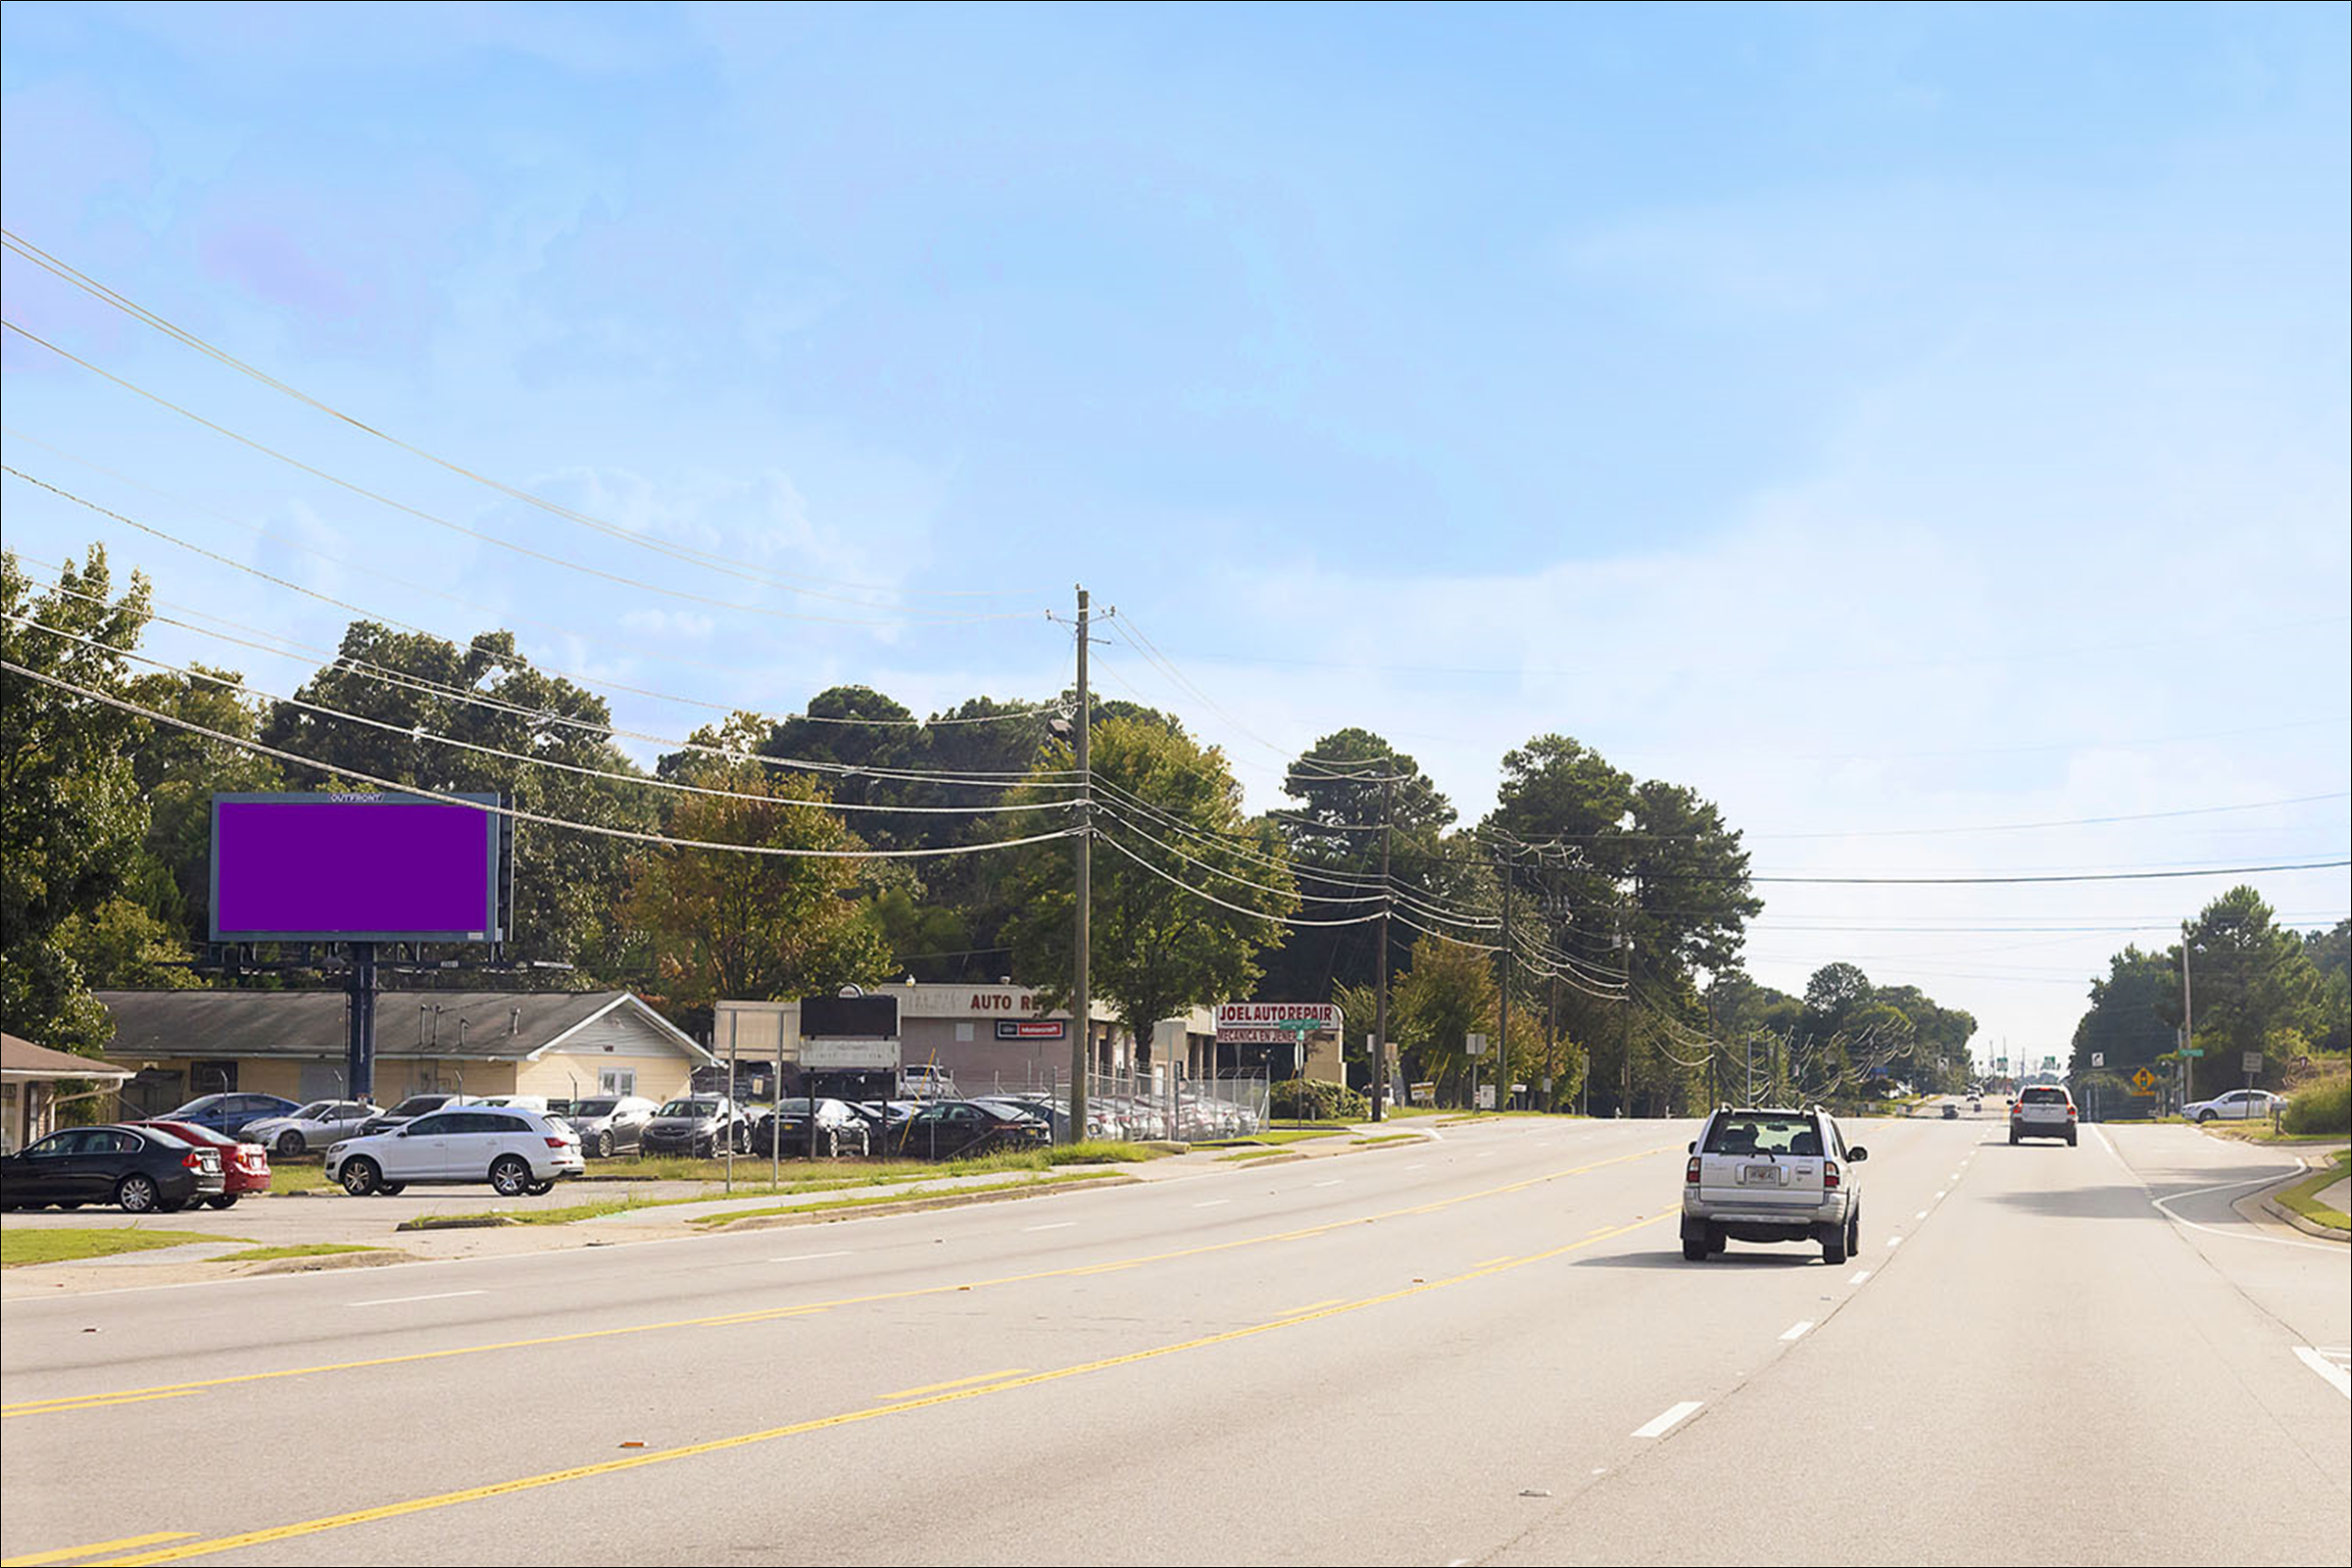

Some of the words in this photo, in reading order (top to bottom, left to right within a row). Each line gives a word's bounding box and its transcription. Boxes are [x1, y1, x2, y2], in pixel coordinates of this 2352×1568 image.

[970, 994, 1012, 1010] AUTO
[1220, 1006, 1251, 1020] JOEL
[1254, 1006, 1286, 1020] AUTO
[1288, 1006, 1332, 1020] REPAIR
